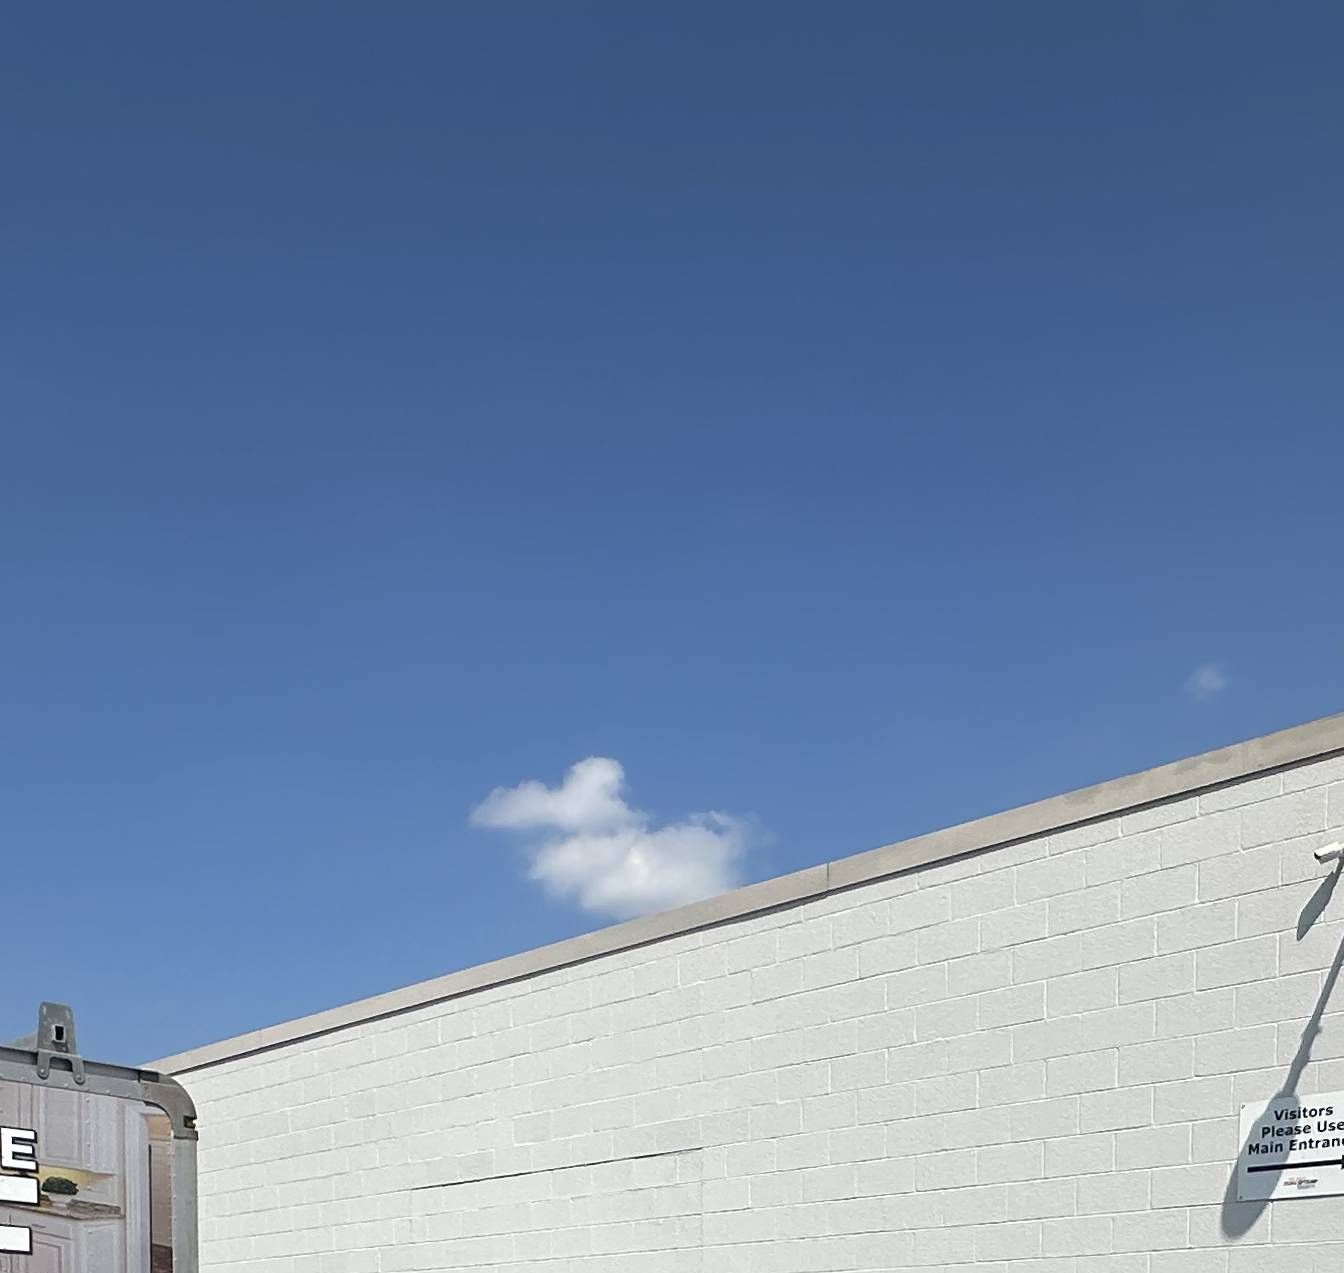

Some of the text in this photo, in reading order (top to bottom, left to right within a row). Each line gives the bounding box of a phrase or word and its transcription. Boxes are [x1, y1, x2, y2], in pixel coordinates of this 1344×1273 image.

[1274, 1106, 1334, 1121] Visitors
[1261, 1125, 1312, 1139] Please
[1248, 1142, 1283, 1156] Main
